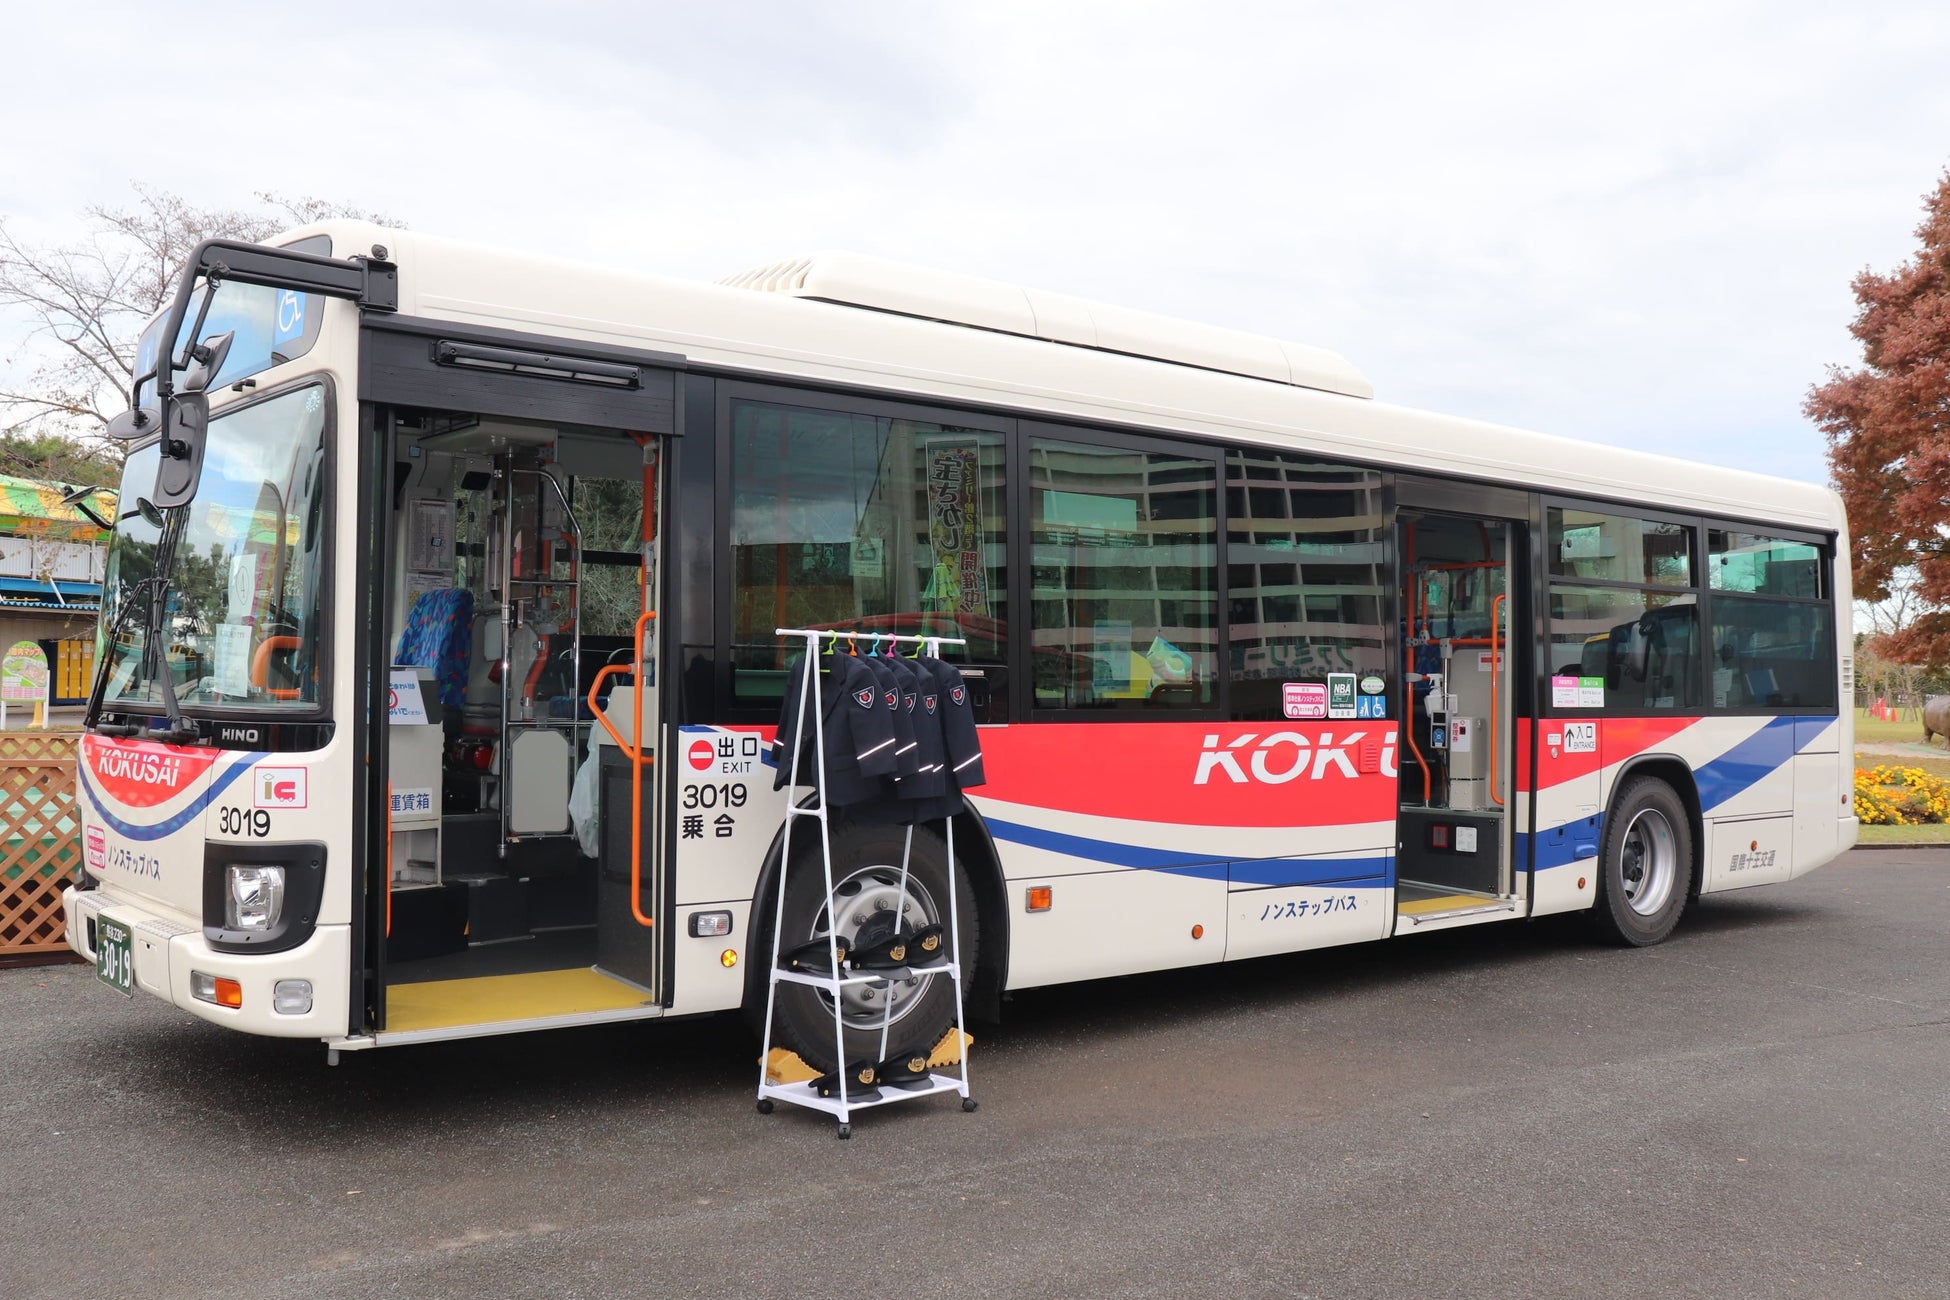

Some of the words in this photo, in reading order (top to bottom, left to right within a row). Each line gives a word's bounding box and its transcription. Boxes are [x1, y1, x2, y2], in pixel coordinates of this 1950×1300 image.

[1333, 683, 1351, 694] NBA
[221, 728, 259, 743] HINO
[718, 736, 757, 757] 出口
[98, 748, 181, 787] KOKUSAI
[722, 761, 752, 773] EXIT
[682, 783, 747, 809] 3019
[220, 806, 271, 837] 3019
[682, 813, 735, 839] 乗合
[108, 842, 161, 881] ノンステップバス
[1260, 895, 1358, 921] ノンステップバス
[101, 939, 131, 988] 30-19
